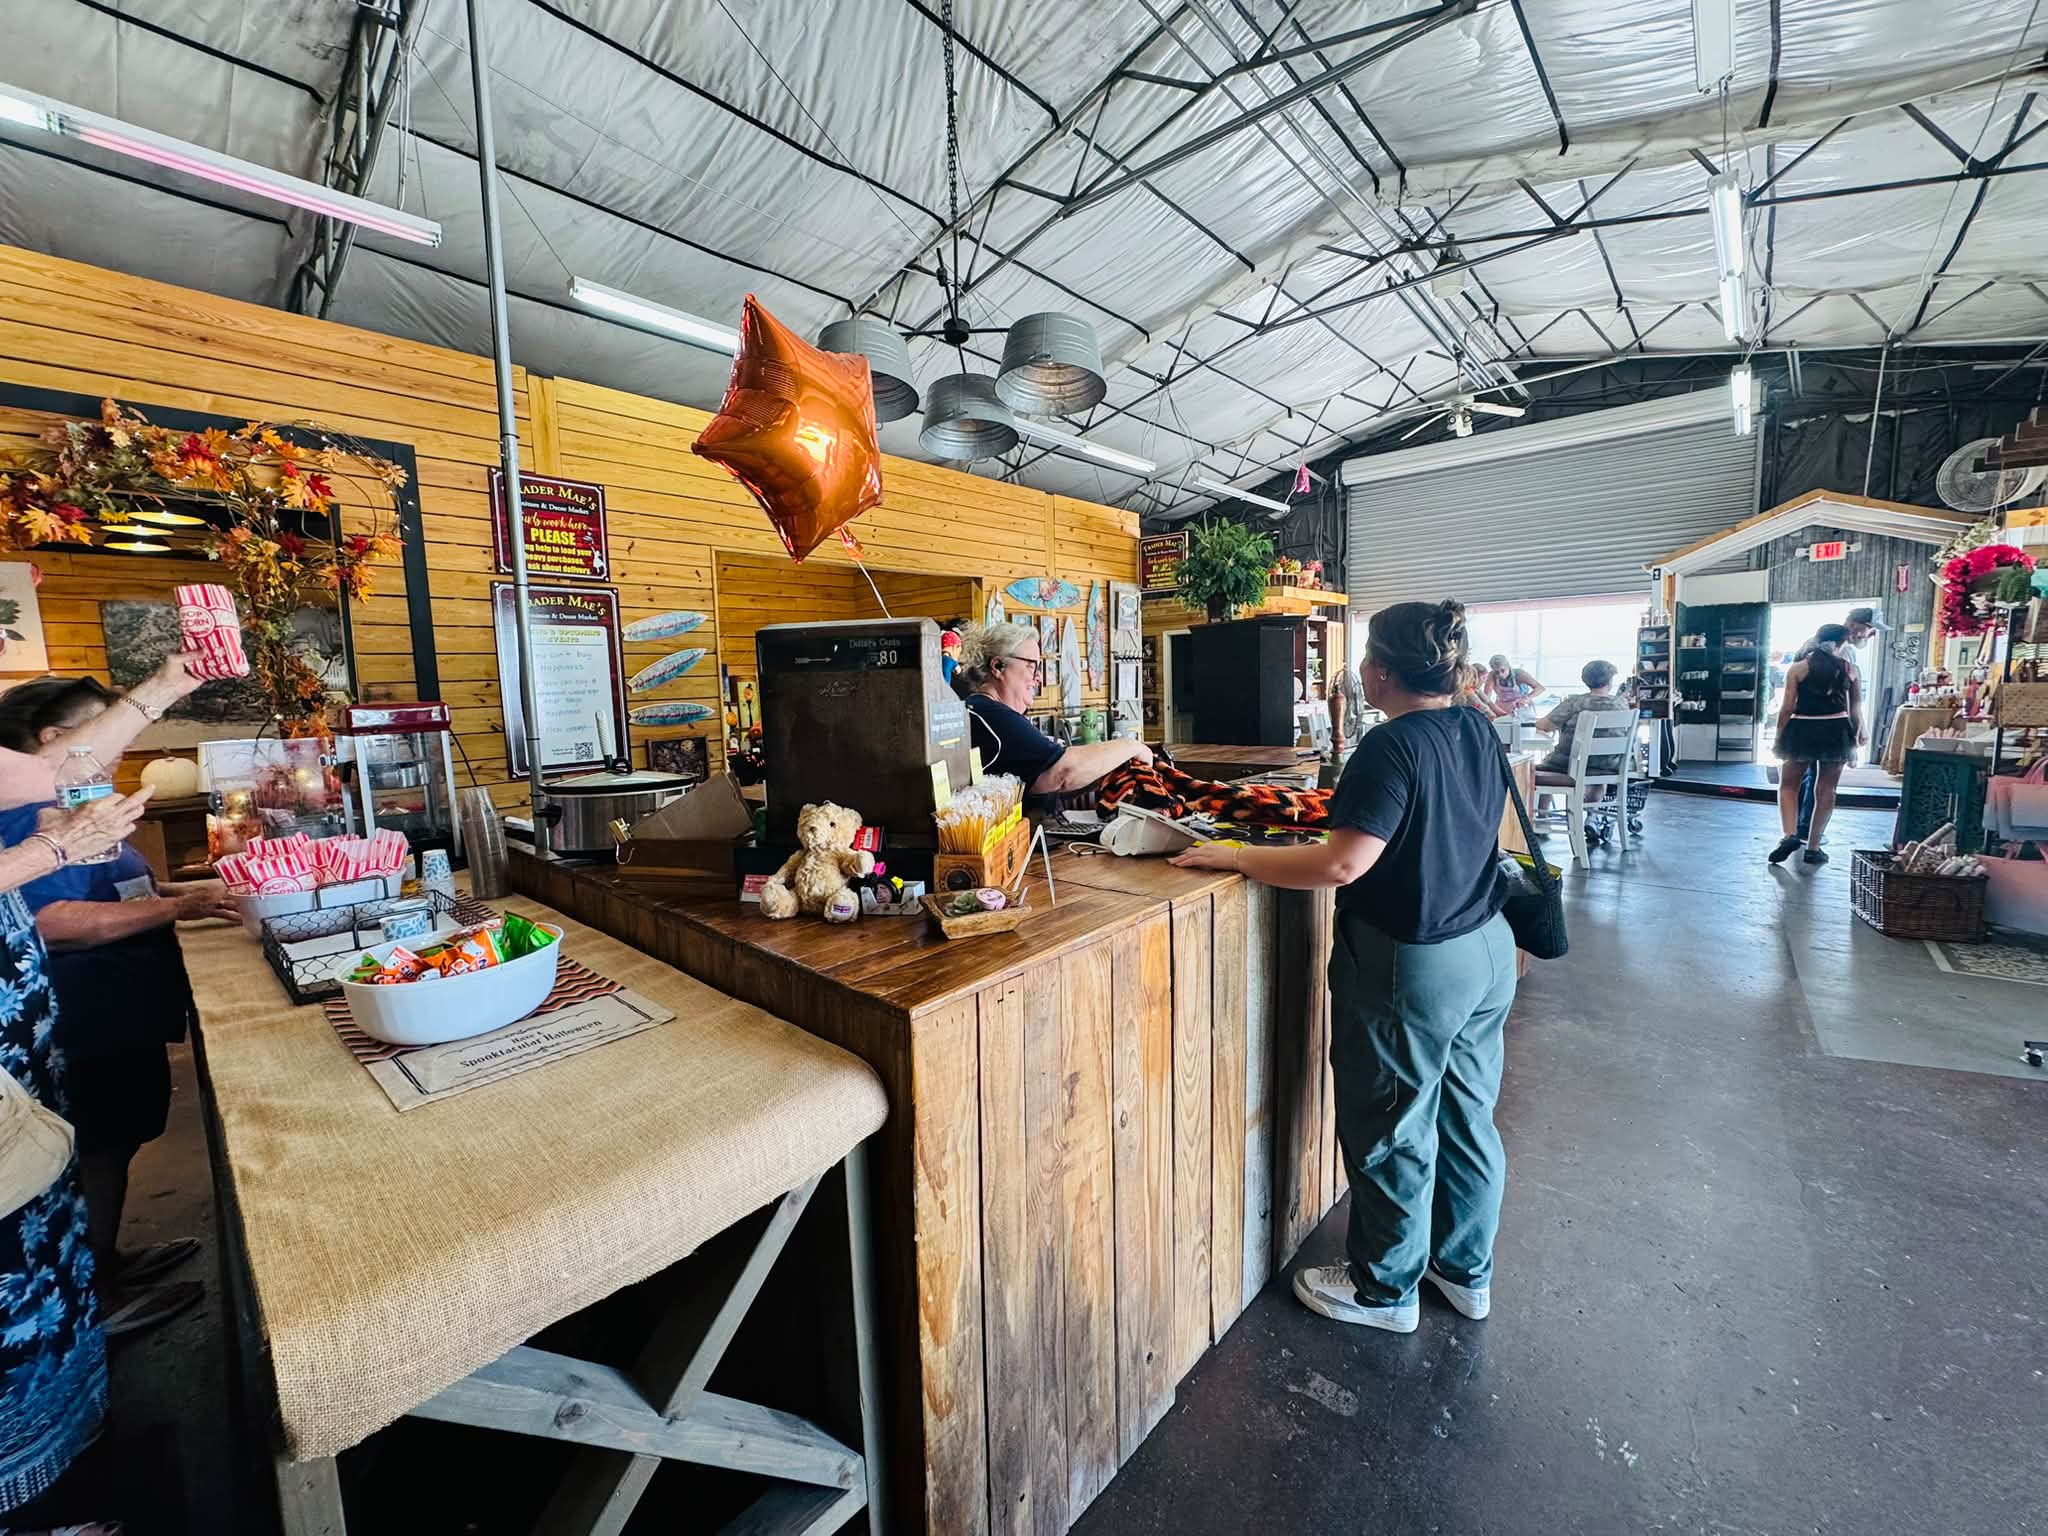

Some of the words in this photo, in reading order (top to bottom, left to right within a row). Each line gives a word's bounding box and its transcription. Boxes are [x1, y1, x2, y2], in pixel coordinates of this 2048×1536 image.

[519, 485, 554, 496] ADER
[543, 516, 566, 528] work
[530, 528, 576, 545] PLEASE
[1815, 542, 1841, 559] EXIT
[527, 596, 565, 608] RADER
[568, 595, 606, 616] MAE'S
[264, 881, 288, 892] POP
[459, 1038, 544, 1068] Spooktacular
[543, 1019, 603, 1042] Halloween
